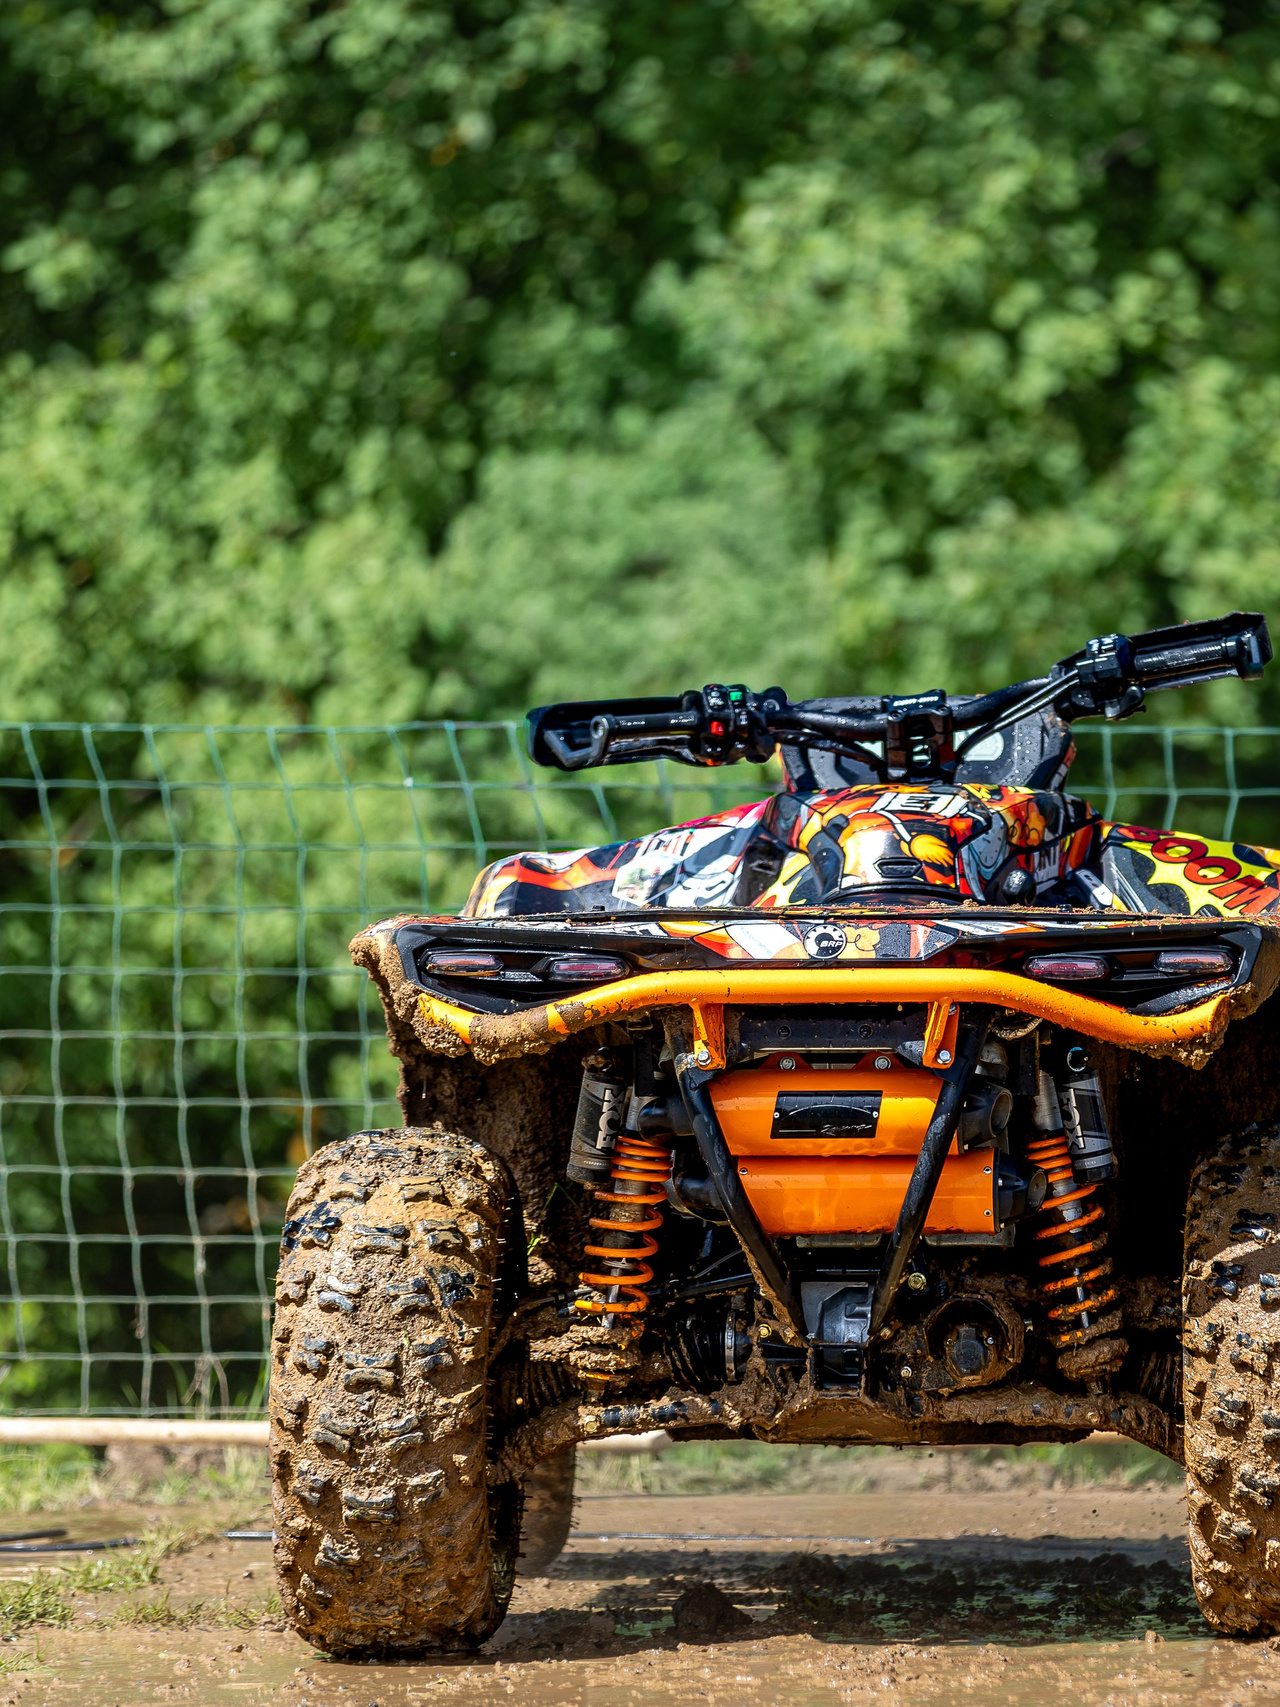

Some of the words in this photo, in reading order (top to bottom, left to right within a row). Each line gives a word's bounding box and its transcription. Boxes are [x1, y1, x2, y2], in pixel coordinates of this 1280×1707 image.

[1117, 825, 1279, 915] BOOM
[820, 940, 843, 948] BRP
[596, 1089, 624, 1150] FOX
[1060, 1088, 1085, 1148] FOX
